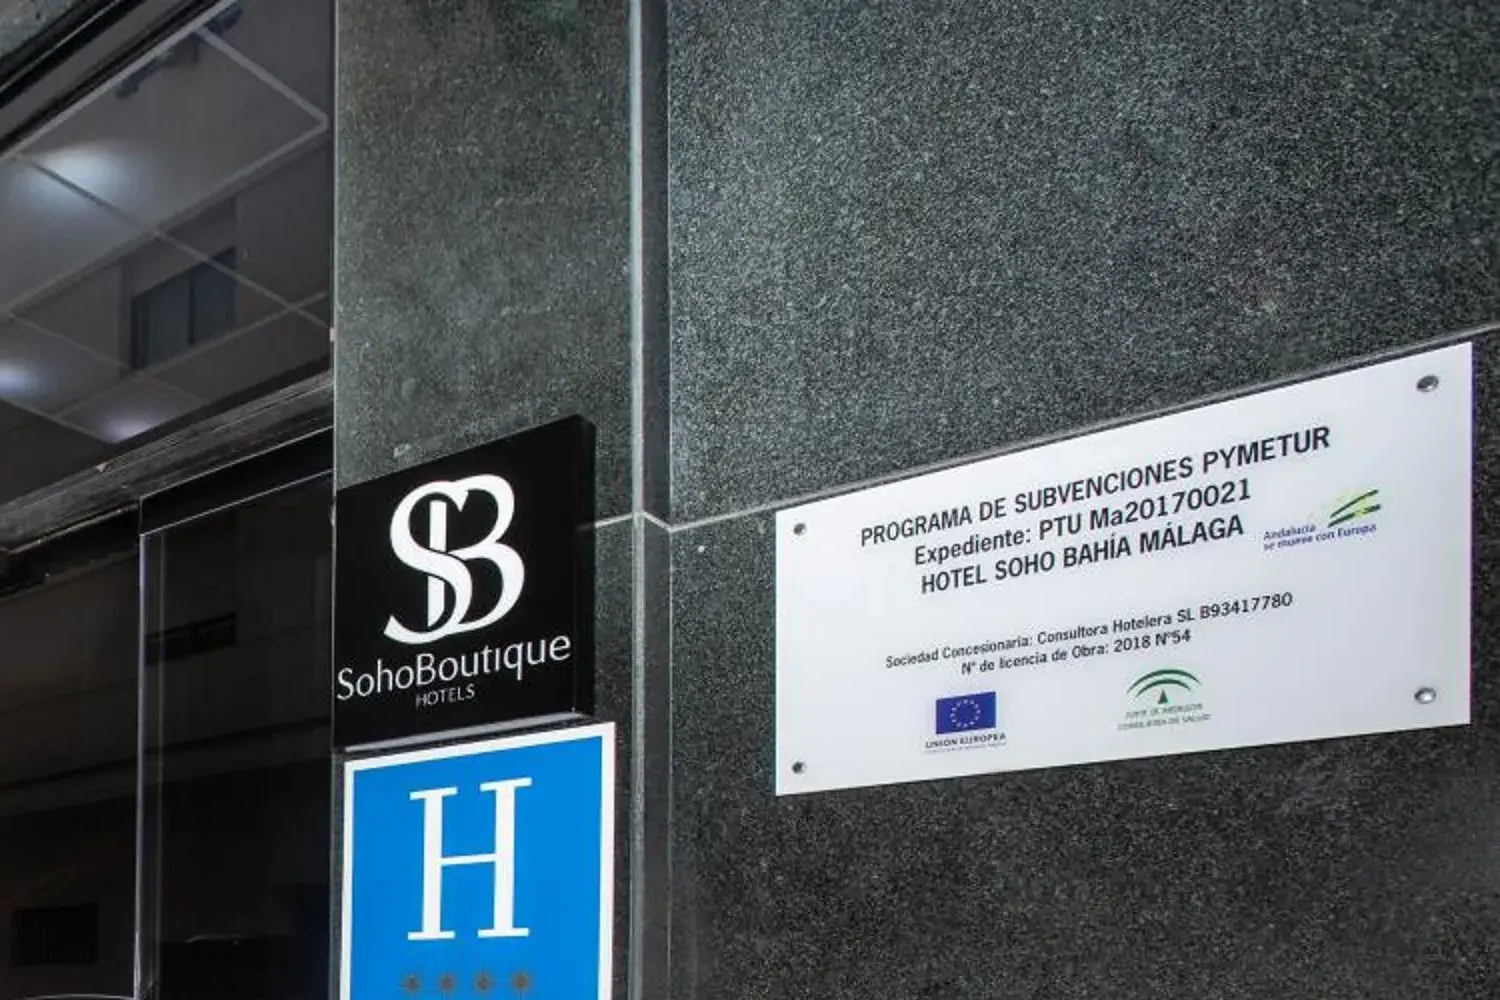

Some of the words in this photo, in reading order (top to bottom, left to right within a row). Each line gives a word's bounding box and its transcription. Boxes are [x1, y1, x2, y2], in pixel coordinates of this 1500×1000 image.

[861, 506, 972, 547] PROGRAMA
[979, 498, 1006, 521] DE
[1015, 456, 1193, 513] SUBVENCIONES
[1203, 426, 1330, 473] PYMETUR
[915, 528, 1031, 565] Expediente:
[1039, 513, 1083, 540] PTU
[1089, 478, 1250, 530] Ma20170021
[921, 564, 986, 594] HOTEL
[995, 551, 1055, 581] SOHO
[1063, 533, 1131, 568] BAHÍA
[1139, 515, 1244, 554] MÁLAGA
[336, 634, 571, 701] SohoBoutique
[885, 649, 939, 669] Sociedad
[942, 636, 1032, 660] Concesionaria:
[1037, 622, 1108, 645] Consultora
[1113, 613, 1172, 633] Hotelera
[1177, 607, 1195, 623] SL
[1200, 592, 1293, 619] B93417780
[980, 659, 995, 672] de
[1000, 649, 1047, 669] licencia
[1051, 647, 1067, 661] de
[1071, 642, 1110, 659] Obra:
[1113, 635, 1150, 653] 2018
[415, 683, 476, 708] HOTELS
[407, 777, 532, 942] H
